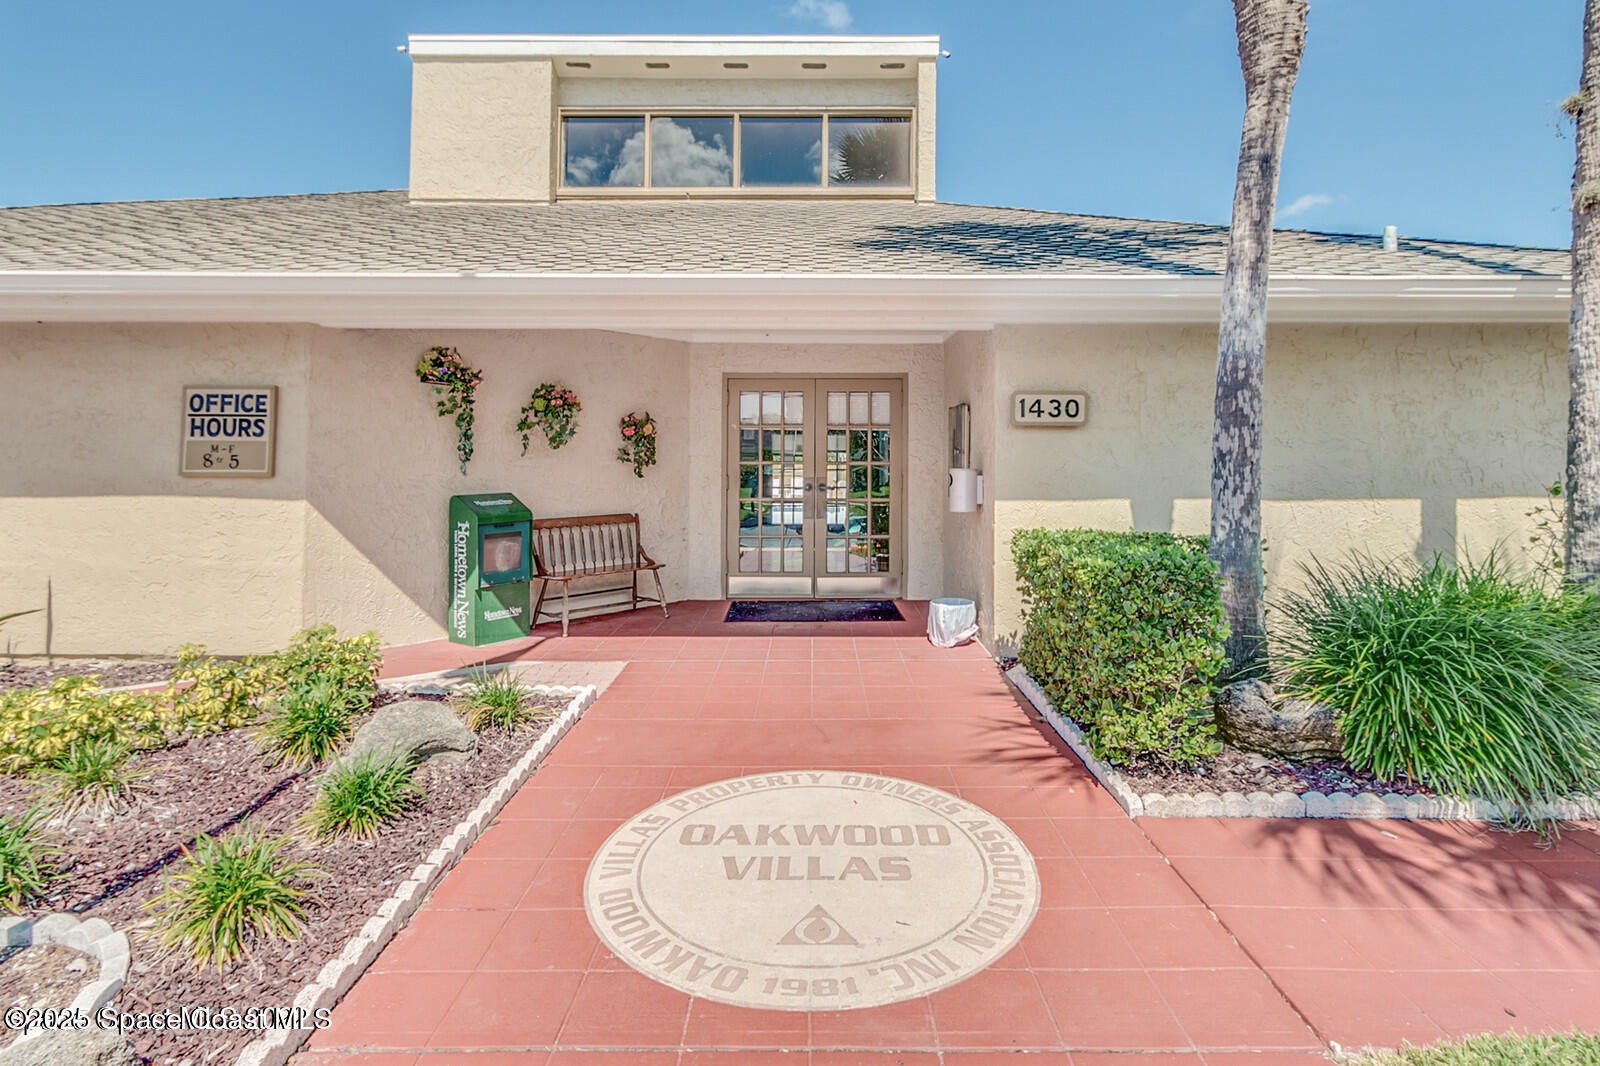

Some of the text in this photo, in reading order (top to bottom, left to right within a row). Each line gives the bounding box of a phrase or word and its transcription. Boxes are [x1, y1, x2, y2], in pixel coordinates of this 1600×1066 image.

[189, 393, 268, 413] OFFICE
[1019, 398, 1080, 418] 1430
[190, 417, 266, 437] HOURS
[203, 453, 214, 469] 8
[229, 454, 240, 469] 5
[457, 520, 470, 639] Hometown News
[667, 773, 825, 812] PROPERTY
[841, 775, 968, 816] OWNERS
[599, 813, 671, 881] VILLAS
[679, 824, 952, 847] OAKWOOD
[722, 856, 913, 881] VILLAS
[952, 820, 1026, 956] ASSOCIATION
[598, 887, 749, 993] OAKWOOD
[762, 976, 860, 997] 1981
